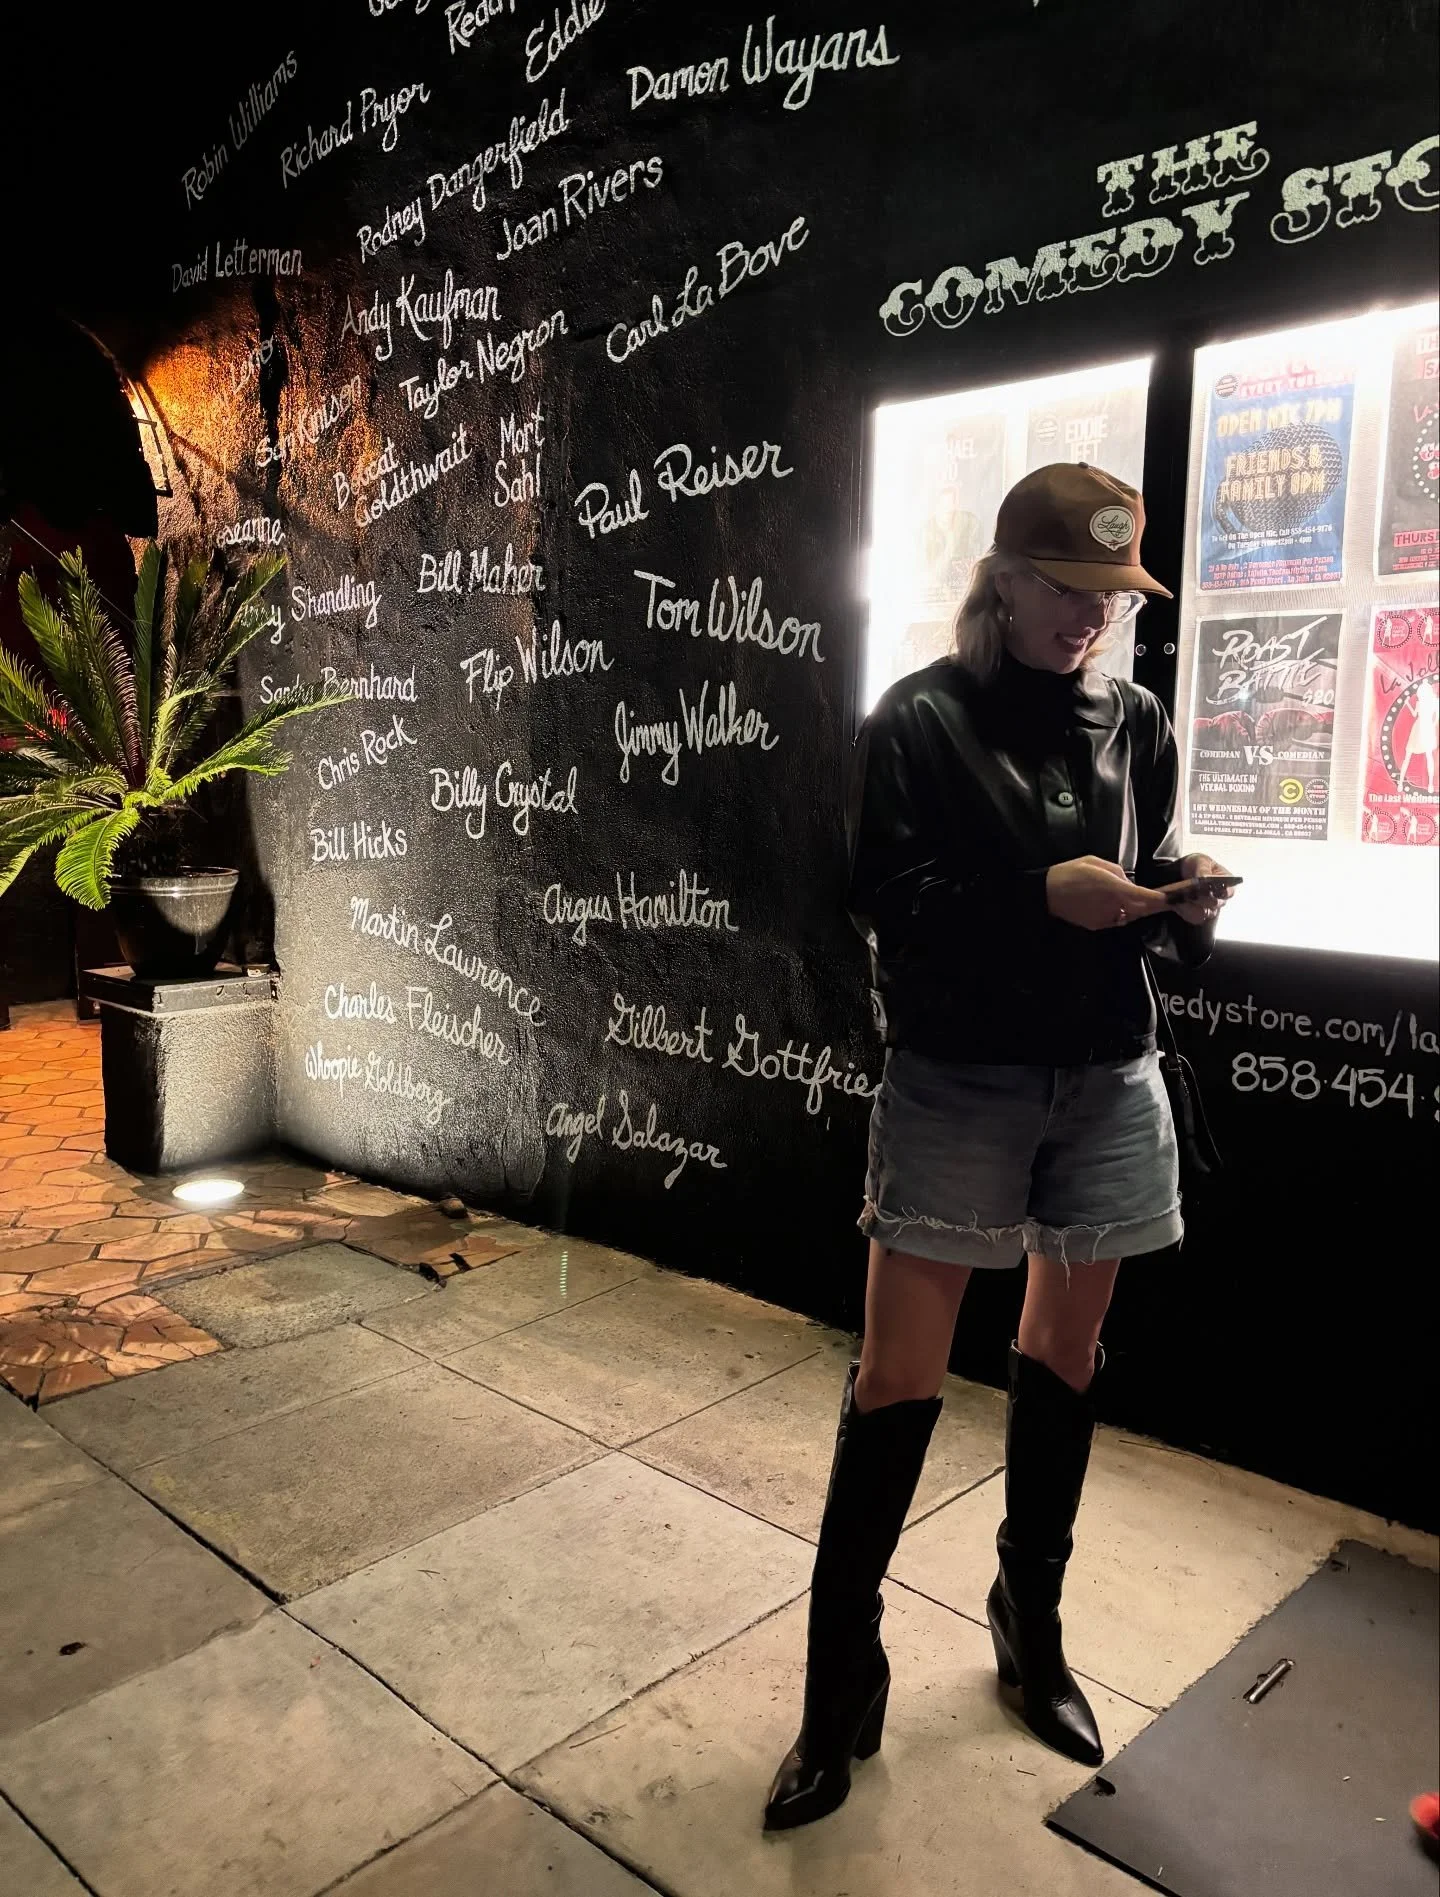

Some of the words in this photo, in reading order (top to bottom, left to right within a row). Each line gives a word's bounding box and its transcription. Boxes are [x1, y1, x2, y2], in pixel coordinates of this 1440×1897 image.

[626, 57, 729, 110] Damon
[742, 15, 900, 110] Wayans
[181, 143, 229, 210] Robin
[228, 50, 298, 151] Williams
[280, 101, 353, 188] Richard
[360, 82, 431, 152] Pryor
[1097, 121, 1270, 218] THE
[357, 197, 425, 263] Rodney
[427, 88, 571, 212] Dangerfield
[497, 206, 558, 260] Joan
[558, 156, 663, 226] Rivers
[171, 247, 207, 293] David
[215, 238, 302, 277] Letterman
[605, 295, 669, 363] Carl
[671, 266, 716, 329] La
[717, 216, 809, 299] Bove
[879, 191, 1249, 336] COMEDY
[340, 290, 392, 361] Andy
[396, 268, 501, 348] Kaufman
[400, 357, 473, 419] Taylor
[476, 310, 568, 383] Negron
[500, 402, 545, 458] Mort
[1225, 446, 1306, 478] FRIENDS
[354, 422, 473, 527] Goldthwait
[494, 453, 541, 508] Sahl
[574, 469, 650, 539] Paul
[653, 440, 794, 502] Reiser
[1220, 474, 1286, 502] FAMILY
[213, 513, 286, 548] oseanne
[417, 549, 461, 593] Bill
[468, 543, 545, 593] Maher
[1395, 531, 1439, 545] THURS
[291, 574, 382, 629] Shandling
[634, 569, 701, 636] Tom
[708, 575, 825, 662] Wilson
[460, 649, 513, 710] Flip
[515, 619, 615, 684] Wilson
[318, 747, 359, 790] Chris
[360, 714, 417, 765] Rock
[614, 700, 682, 786] Jimmy
[679, 680, 779, 754] Walker
[1243, 745, 1274, 765] VS
[1278, 751, 1325, 760] COMEDIAN
[429, 765, 487, 839] Billy
[495, 761, 578, 836] Crystal
[1209, 804, 1258, 814] WEDNESDAY
[1259, 806, 1270, 814] OF
[1271, 806, 1292, 815] THE
[1293, 807, 1326, 816] MONTH
[1212, 774, 1248, 783] ULTIMATE
[310, 826, 349, 862] Bill
[353, 820, 407, 860] Hicks
[543, 883, 612, 946] Argus
[616, 868, 739, 931] Hamilton
[350, 896, 419, 954] Martin
[424, 914, 546, 1027] Lawrence
[324, 981, 397, 1024] Charles
[405, 986, 512, 1065] Fleischer
[605, 993, 713, 1063] Gilbert
[305, 1040, 362, 1098] Whoopie
[364, 1050, 452, 1125] Goldberg
[545, 1093, 606, 1163] Angel
[611, 1089, 728, 1190] Salazar
